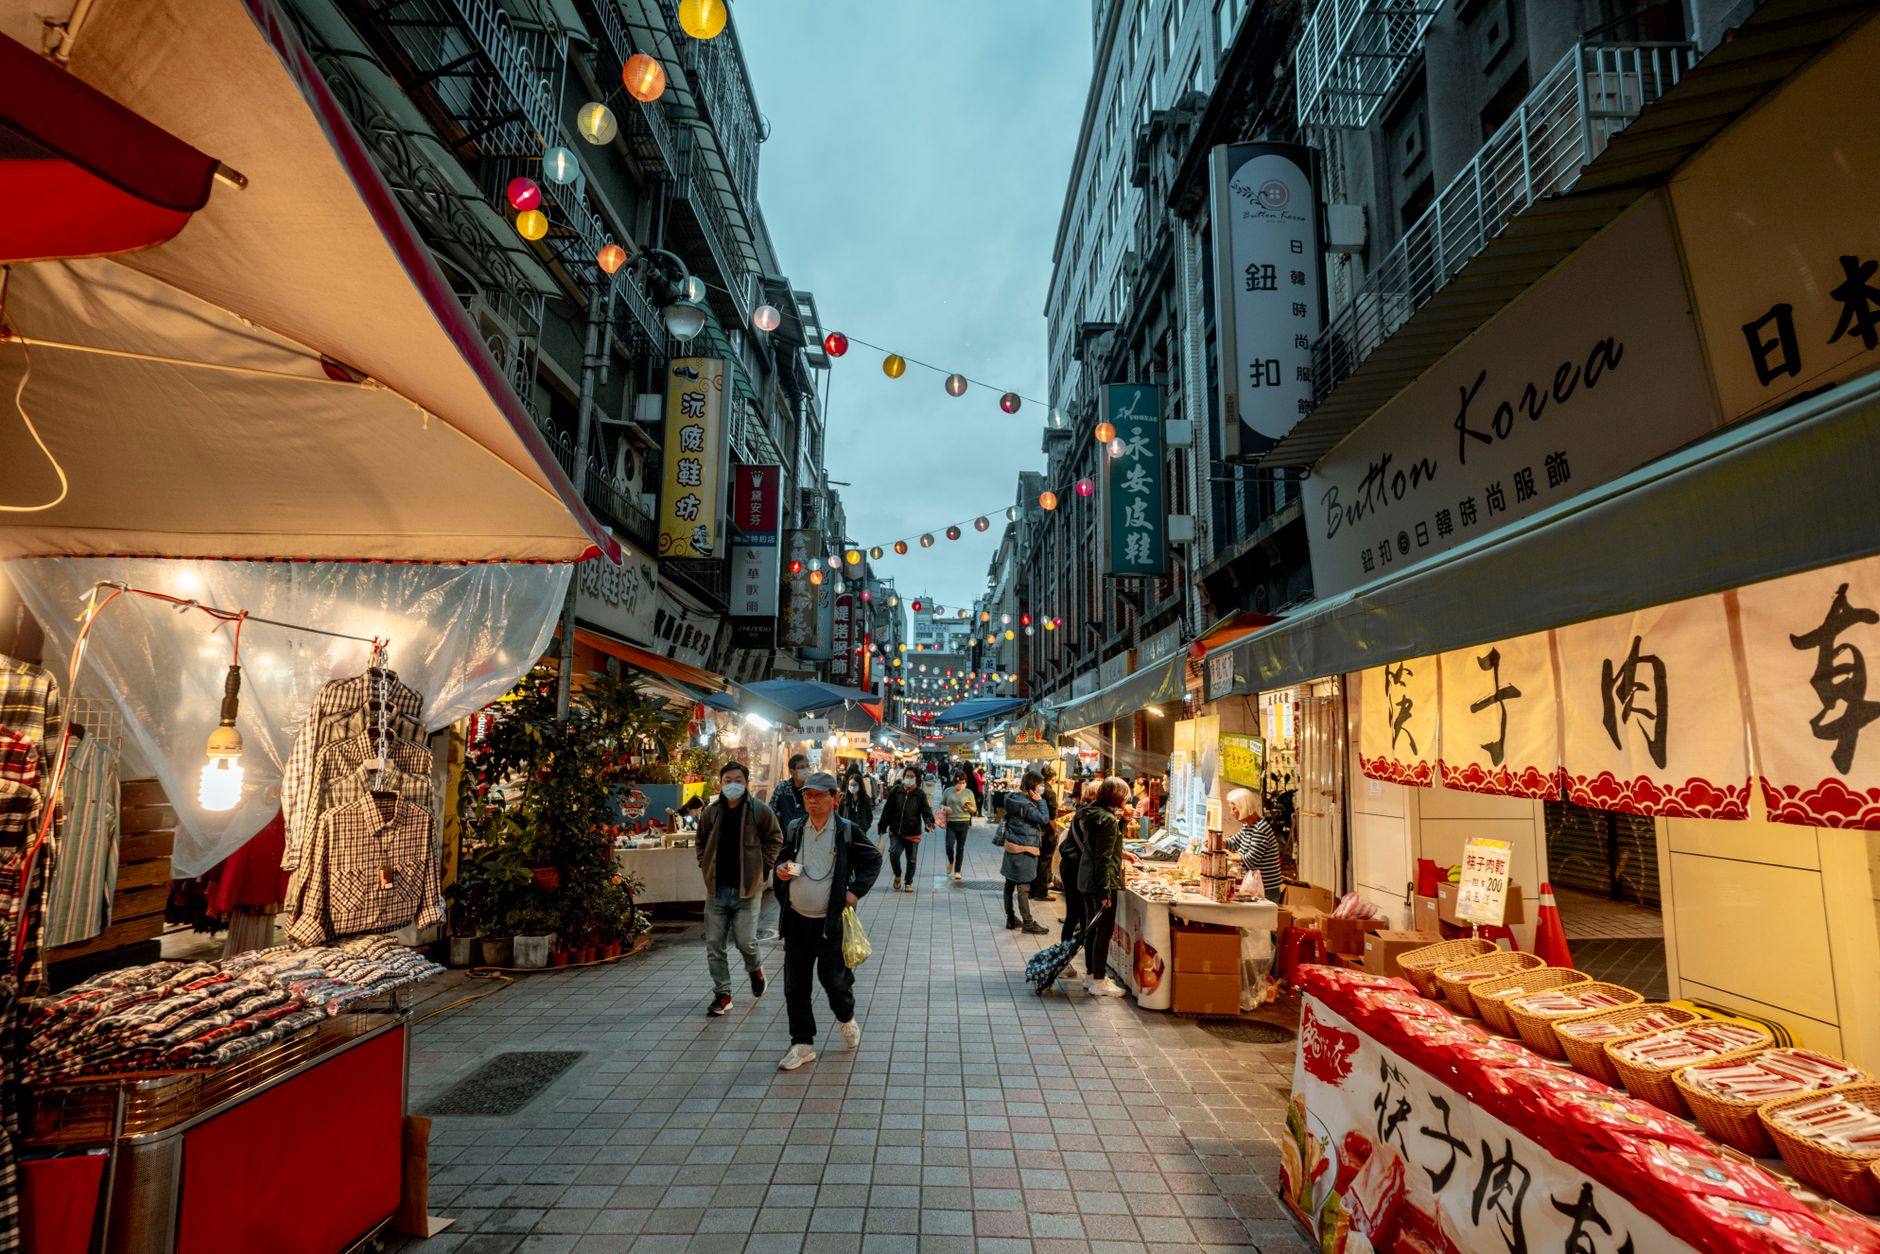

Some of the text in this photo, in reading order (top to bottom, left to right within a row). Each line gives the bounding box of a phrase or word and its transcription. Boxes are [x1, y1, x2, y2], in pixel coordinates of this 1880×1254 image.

[1244, 263, 1281, 388] 鈕扣
[1290, 239, 1314, 414] 日韓時尚服飾
[1742, 255, 1880, 387] 日本
[675, 392, 706, 522] 沅陵鞋坊
[1120, 426, 1154, 565] 永安皮鞋
[1320, 336, 1624, 539] Button Korea
[1466, 855, 1506, 875] 筷子肉乾
